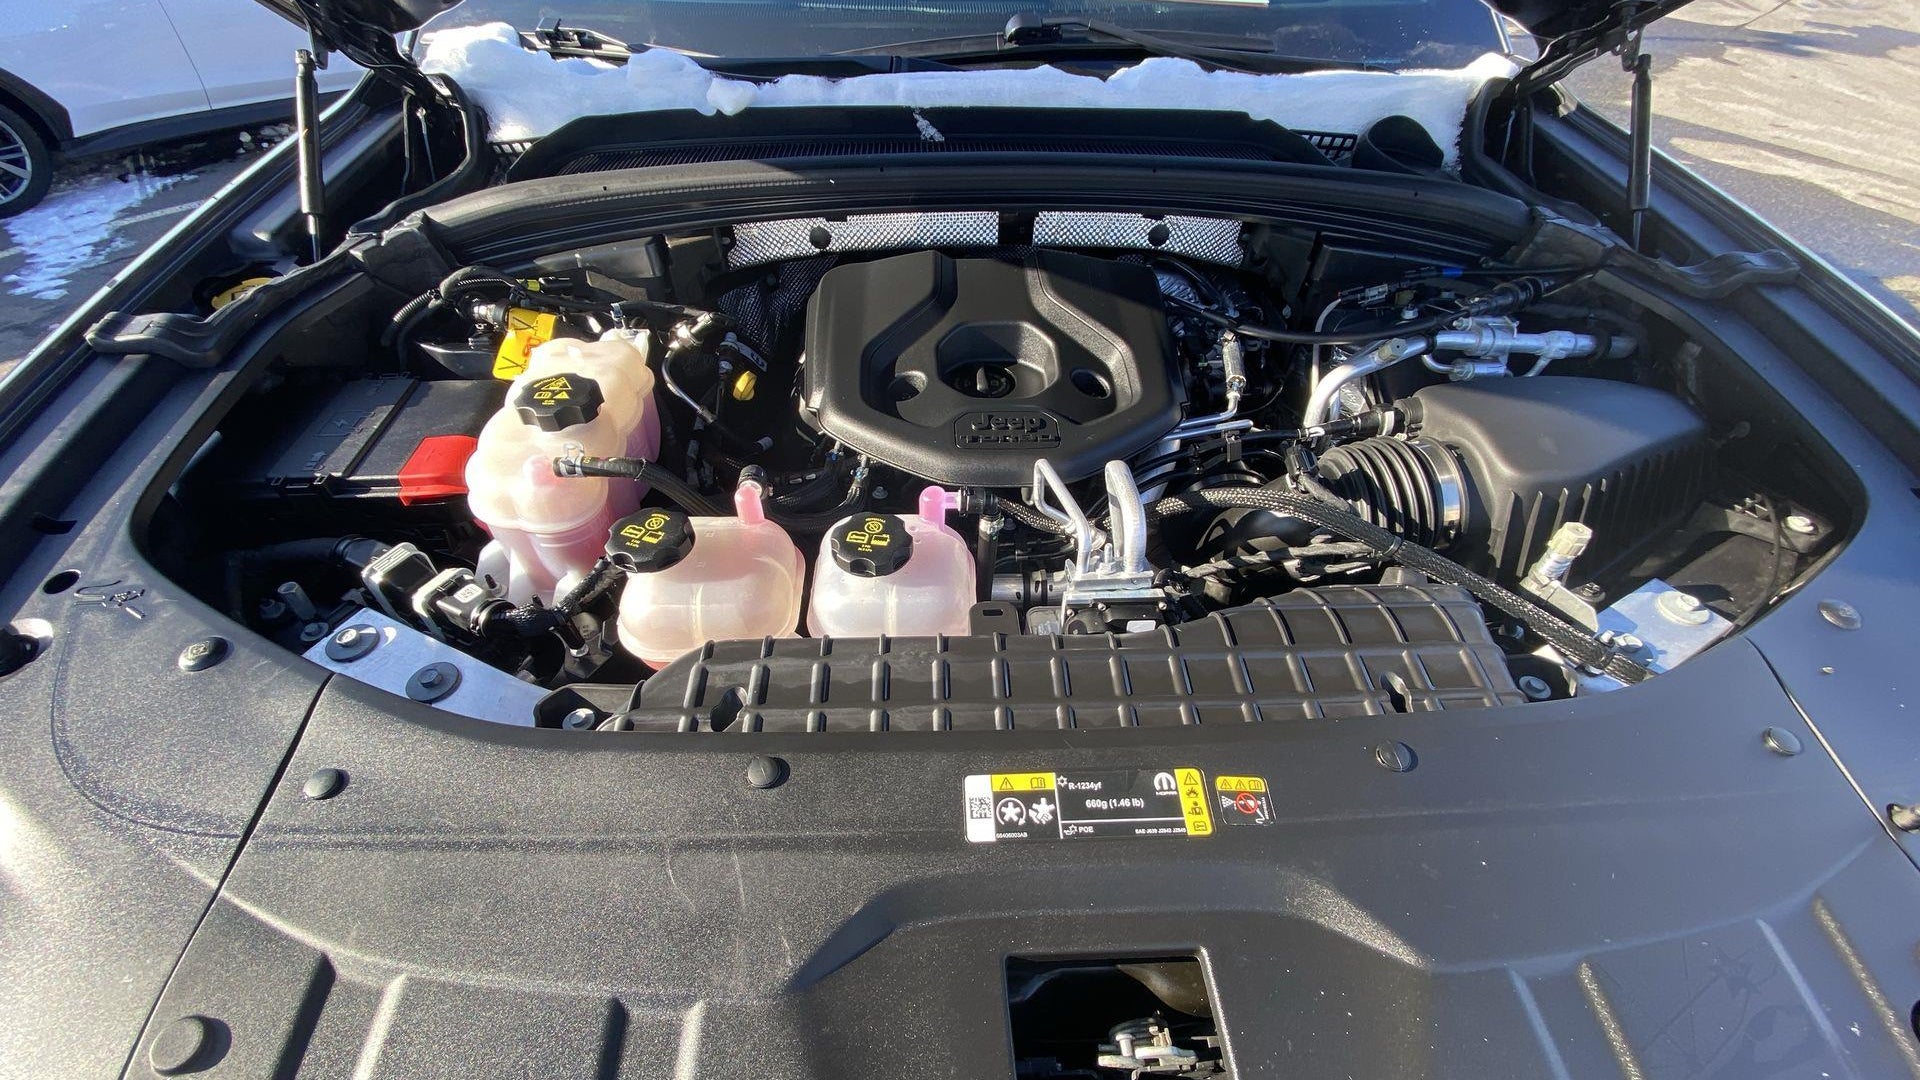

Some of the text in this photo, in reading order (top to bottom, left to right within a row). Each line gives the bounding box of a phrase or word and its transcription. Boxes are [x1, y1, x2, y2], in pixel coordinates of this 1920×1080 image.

[971, 412, 1044, 434] Jeep
[1068, 781, 1102, 790] R-1234yf
[1086, 797, 1145, 810] 660g (1.46 lb)
